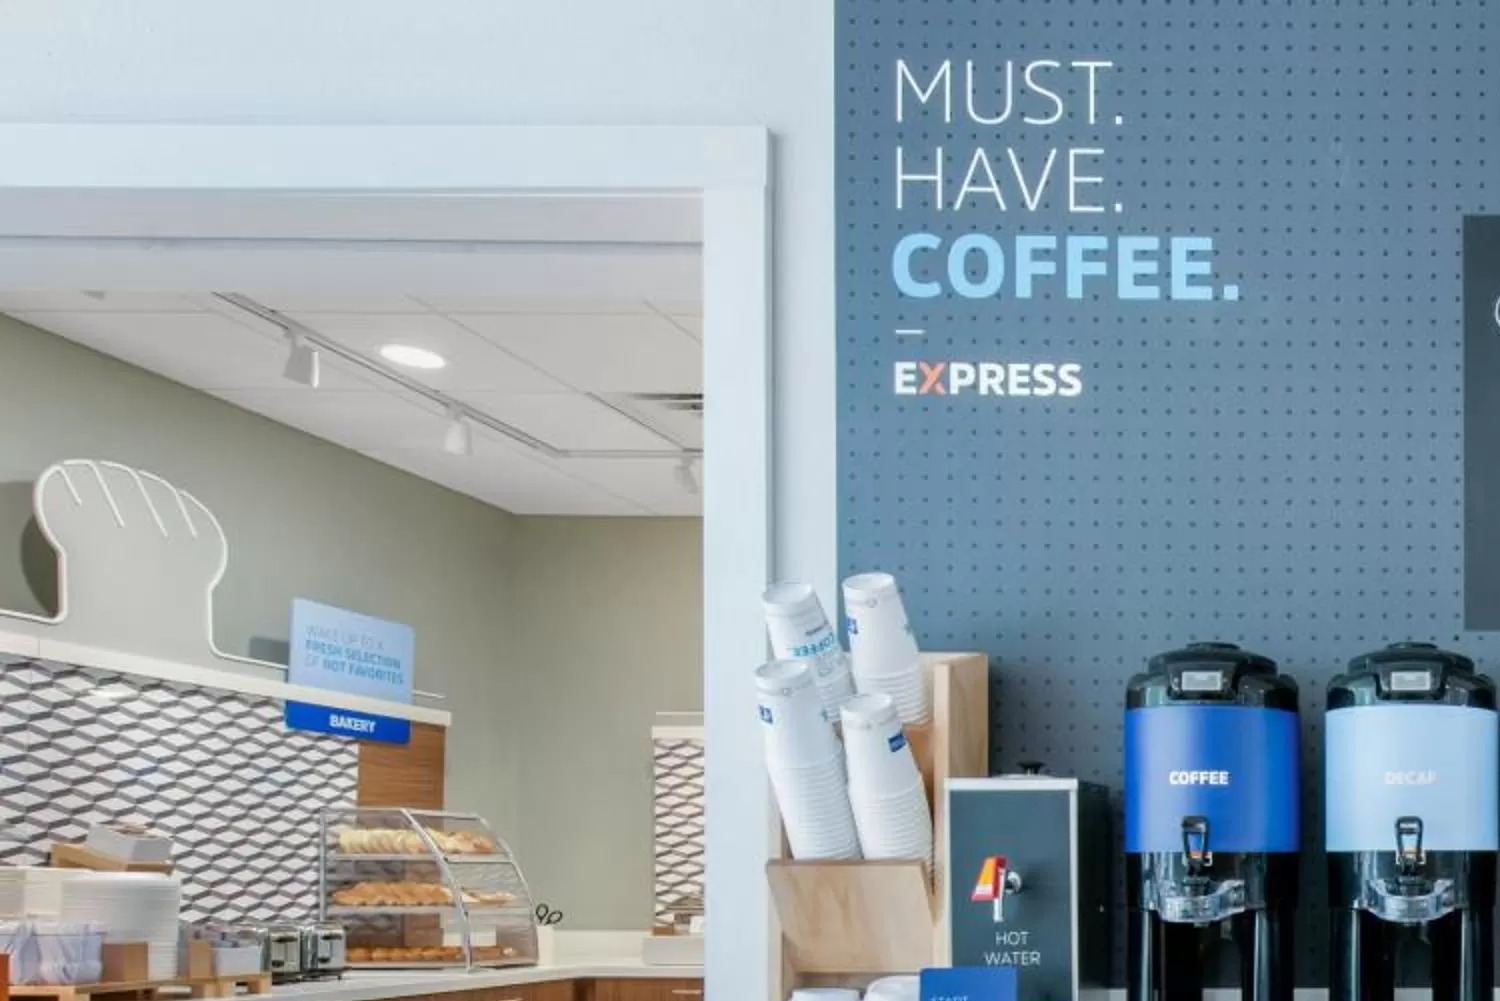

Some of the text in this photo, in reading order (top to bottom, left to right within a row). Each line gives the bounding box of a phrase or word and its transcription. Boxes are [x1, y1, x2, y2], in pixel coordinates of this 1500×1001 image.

[895, 58, 1123, 126] MUST.
[895, 146, 1123, 213] HAVE.
[891, 232, 1239, 301] COFFEE.
[893, 361, 1083, 397] EXPRESS
[329, 713, 377, 733] BAKERY
[1169, 770, 1229, 785] COFFEE
[1385, 771, 1437, 785] DECAF
[995, 931, 1030, 946] HOT
[983, 951, 1041, 966] WATER
